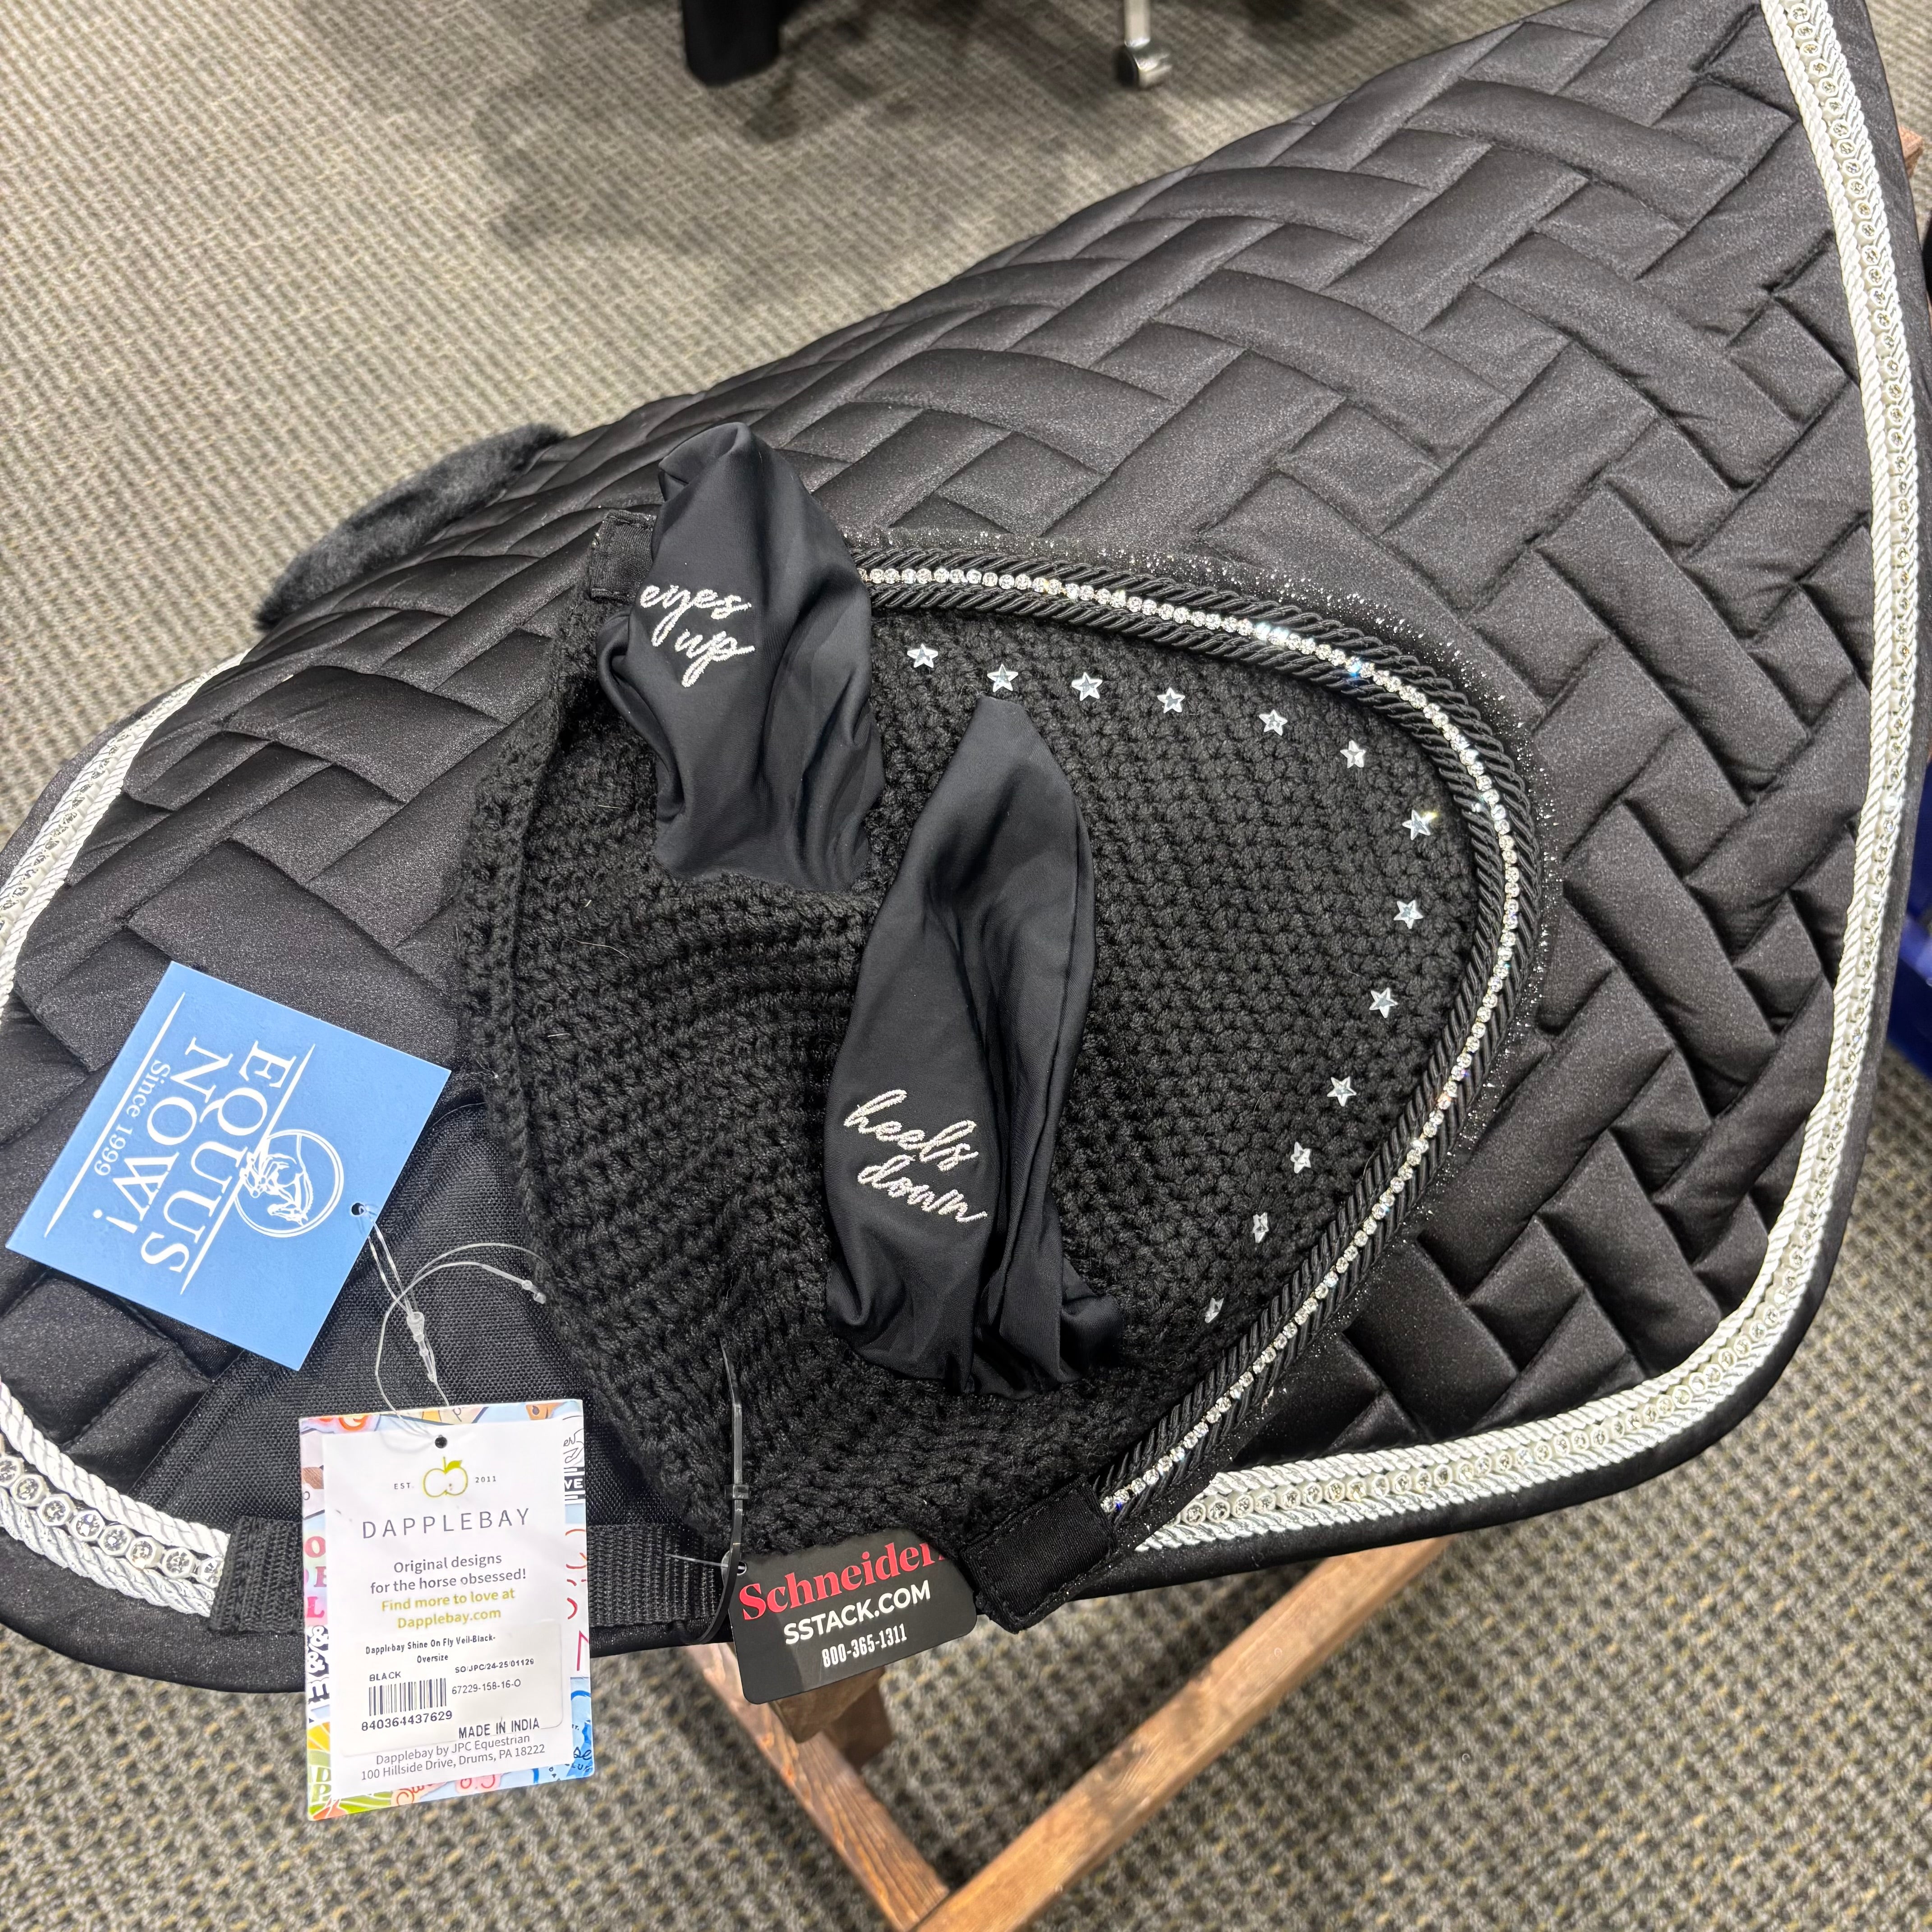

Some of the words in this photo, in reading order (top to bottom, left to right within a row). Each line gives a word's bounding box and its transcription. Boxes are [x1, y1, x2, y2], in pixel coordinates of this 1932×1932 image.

[640, 585, 752, 647] eyes
[675, 629, 755, 687] up
[126, 1060, 171, 1117] Since
[93, 1037, 233, 1233] NOW!
[844, 1089, 979, 1172] heels
[94, 1124, 133, 1176] 1999
[140, 1041, 296, 1272] EQUUS
[857, 1155, 988, 1223] down
[363, 1508, 529, 1539] DAPPLEBAY
[370, 1582, 390, 1594] for
[393, 1580, 415, 1592] the
[419, 1578, 456, 1589] horse
[460, 1569, 526, 1585] obsessed!
[394, 1557, 448, 1574] Original
[451, 1555, 502, 1568] designs
[739, 1542, 945, 1620] Schneider
[381, 1598, 411, 1611] Find
[415, 1596, 450, 1608] more
[453, 1594, 467, 1604] to
[471, 1592, 498, 1602] love
[502, 1588, 515, 1599] at
[783, 1579, 931, 1645] SSTACK.COM
[398, 1609, 501, 1629] Dapplebay.com
[366, 1644, 405, 1655] Dapplebay
[443, 1638, 454, 1647] Fly
[417, 1654, 448, 1663] Oversize
[821, 1623, 907, 1667] 800-365-1311
[369, 1671, 401, 1681] BLACK
[362, 1711, 452, 1731] 840364437629
[459, 1724, 491, 1739] MADE
[496, 1720, 506, 1734] IN
[511, 1718, 540, 1732] INDIA
[361, 1769, 380, 1780] 100
[383, 1763, 423, 1777] Hillside
[426, 1759, 456, 1770] Drive,
[459, 1753, 496, 1765] Drums,
[499, 1749, 512, 1759] PA
[516, 1744, 545, 1757] 18222
[377, 1747, 433, 1765] Dapplebay
[437, 1745, 449, 1756] by
[451, 1742, 472, 1753] JPC
[474, 1735, 530, 1751] Equestrian
